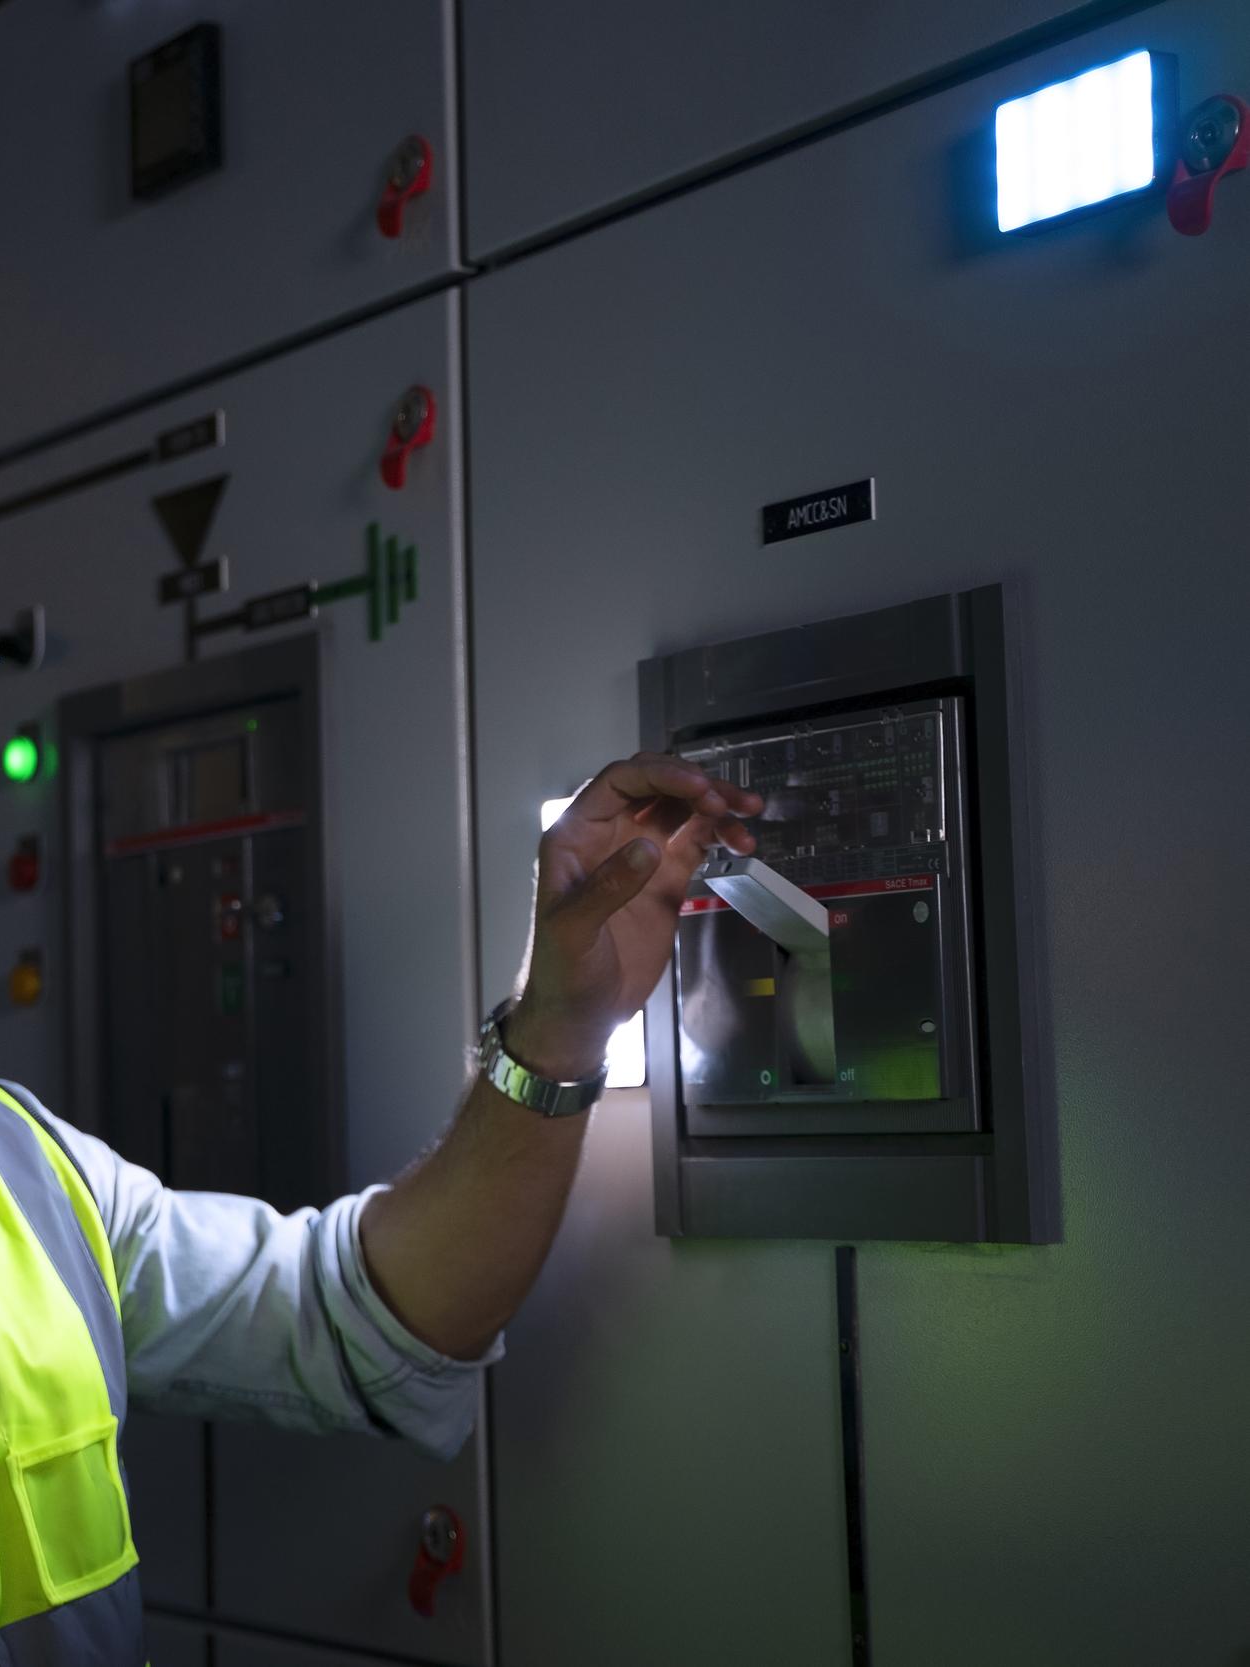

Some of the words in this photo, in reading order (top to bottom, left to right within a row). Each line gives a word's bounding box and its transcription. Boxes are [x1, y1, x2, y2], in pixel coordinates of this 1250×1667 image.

[787, 495, 847, 529] AMCC&SN
[885, 878, 906, 889] SACE
[908, 877, 927, 887] Tmax
[834, 914, 848, 924] on
[840, 1069, 855, 1081] off
